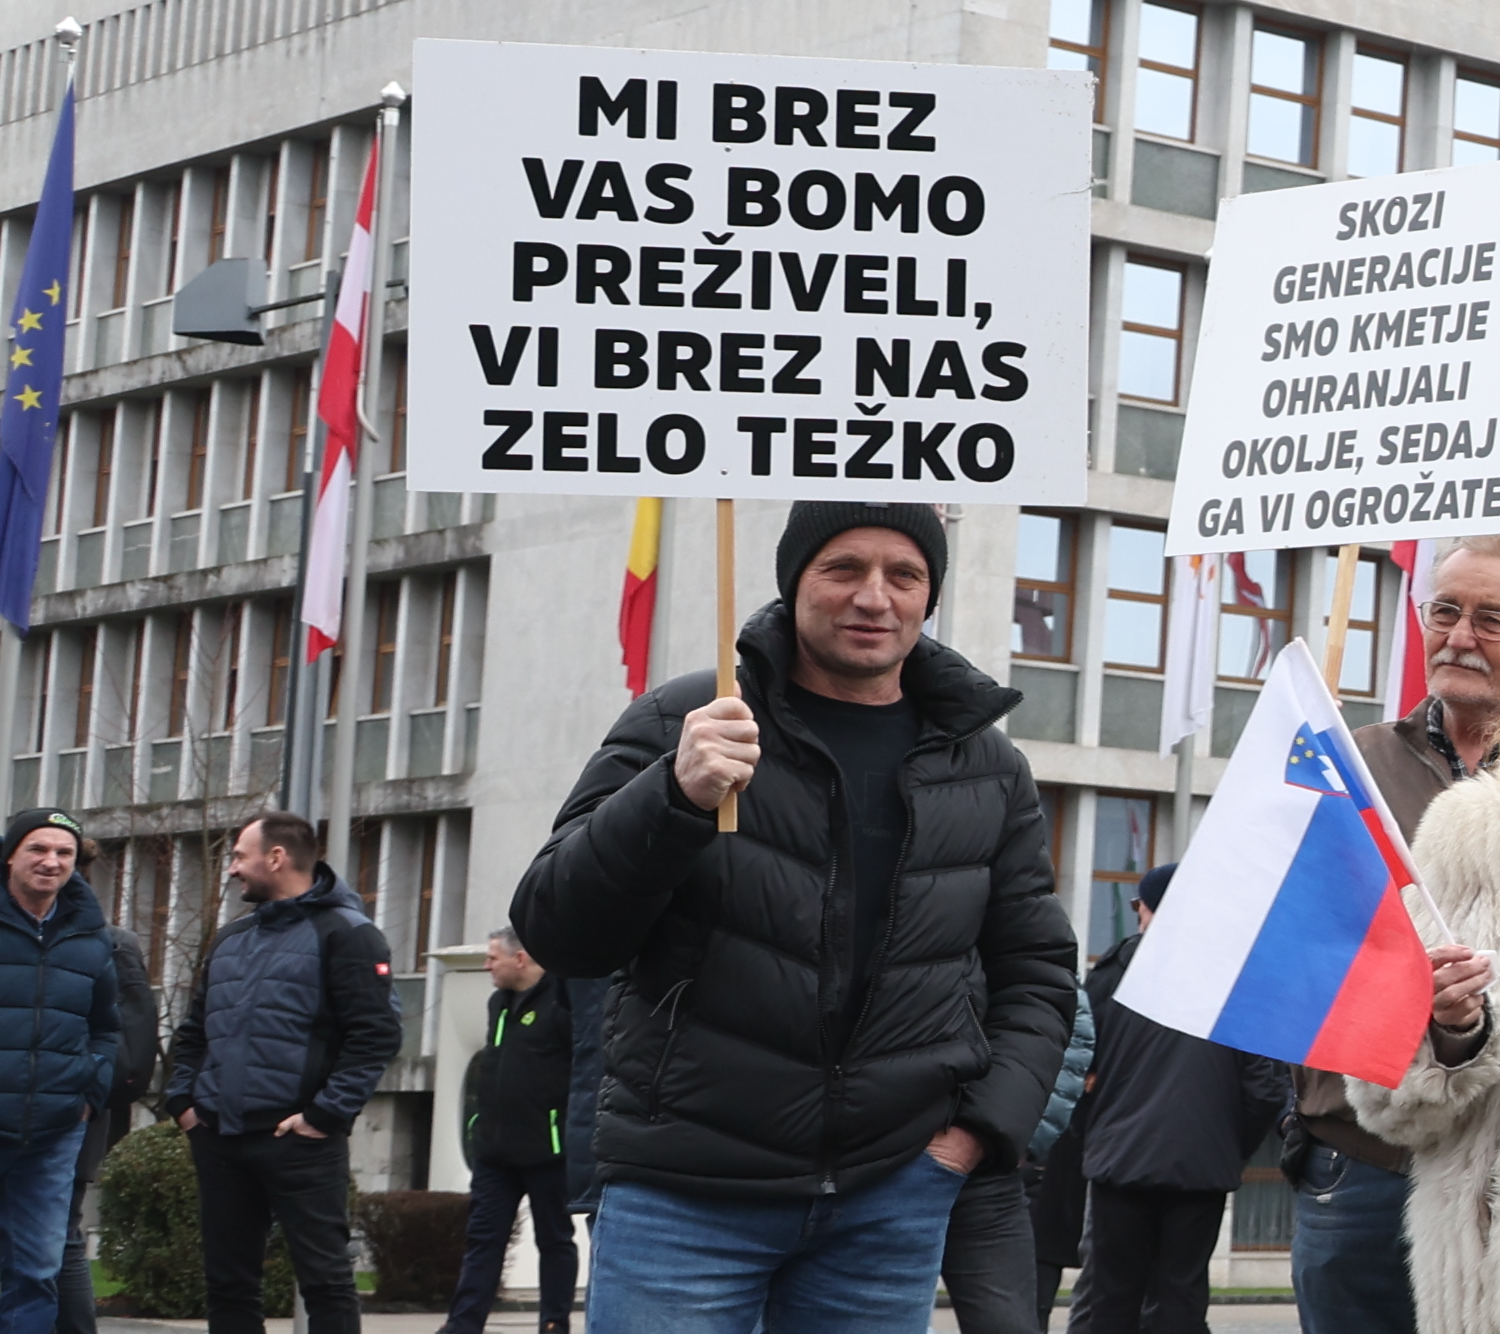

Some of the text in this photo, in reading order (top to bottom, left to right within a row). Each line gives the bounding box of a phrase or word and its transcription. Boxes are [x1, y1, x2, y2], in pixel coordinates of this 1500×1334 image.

[577, 74, 937, 154] MI BREZ
[520, 156, 986, 238] VAS BOMO
[1335, 189, 1446, 242] SKOZI
[511, 230, 993, 331] PREŽIVELI,
[1273, 241, 1497, 305] GENERACIJE
[467, 323, 1030, 403] VI BREZ NAS
[1260, 300, 1491, 363] SMO KMETJE
[1262, 360, 1472, 419] OHRANJALI
[480, 401, 1016, 484] ZELO TEŽKO
[1221, 417, 1498, 480] OKOLJE, SEDAJ
[1197, 496, 1245, 539] GA
[1260, 492, 1296, 534] VI
